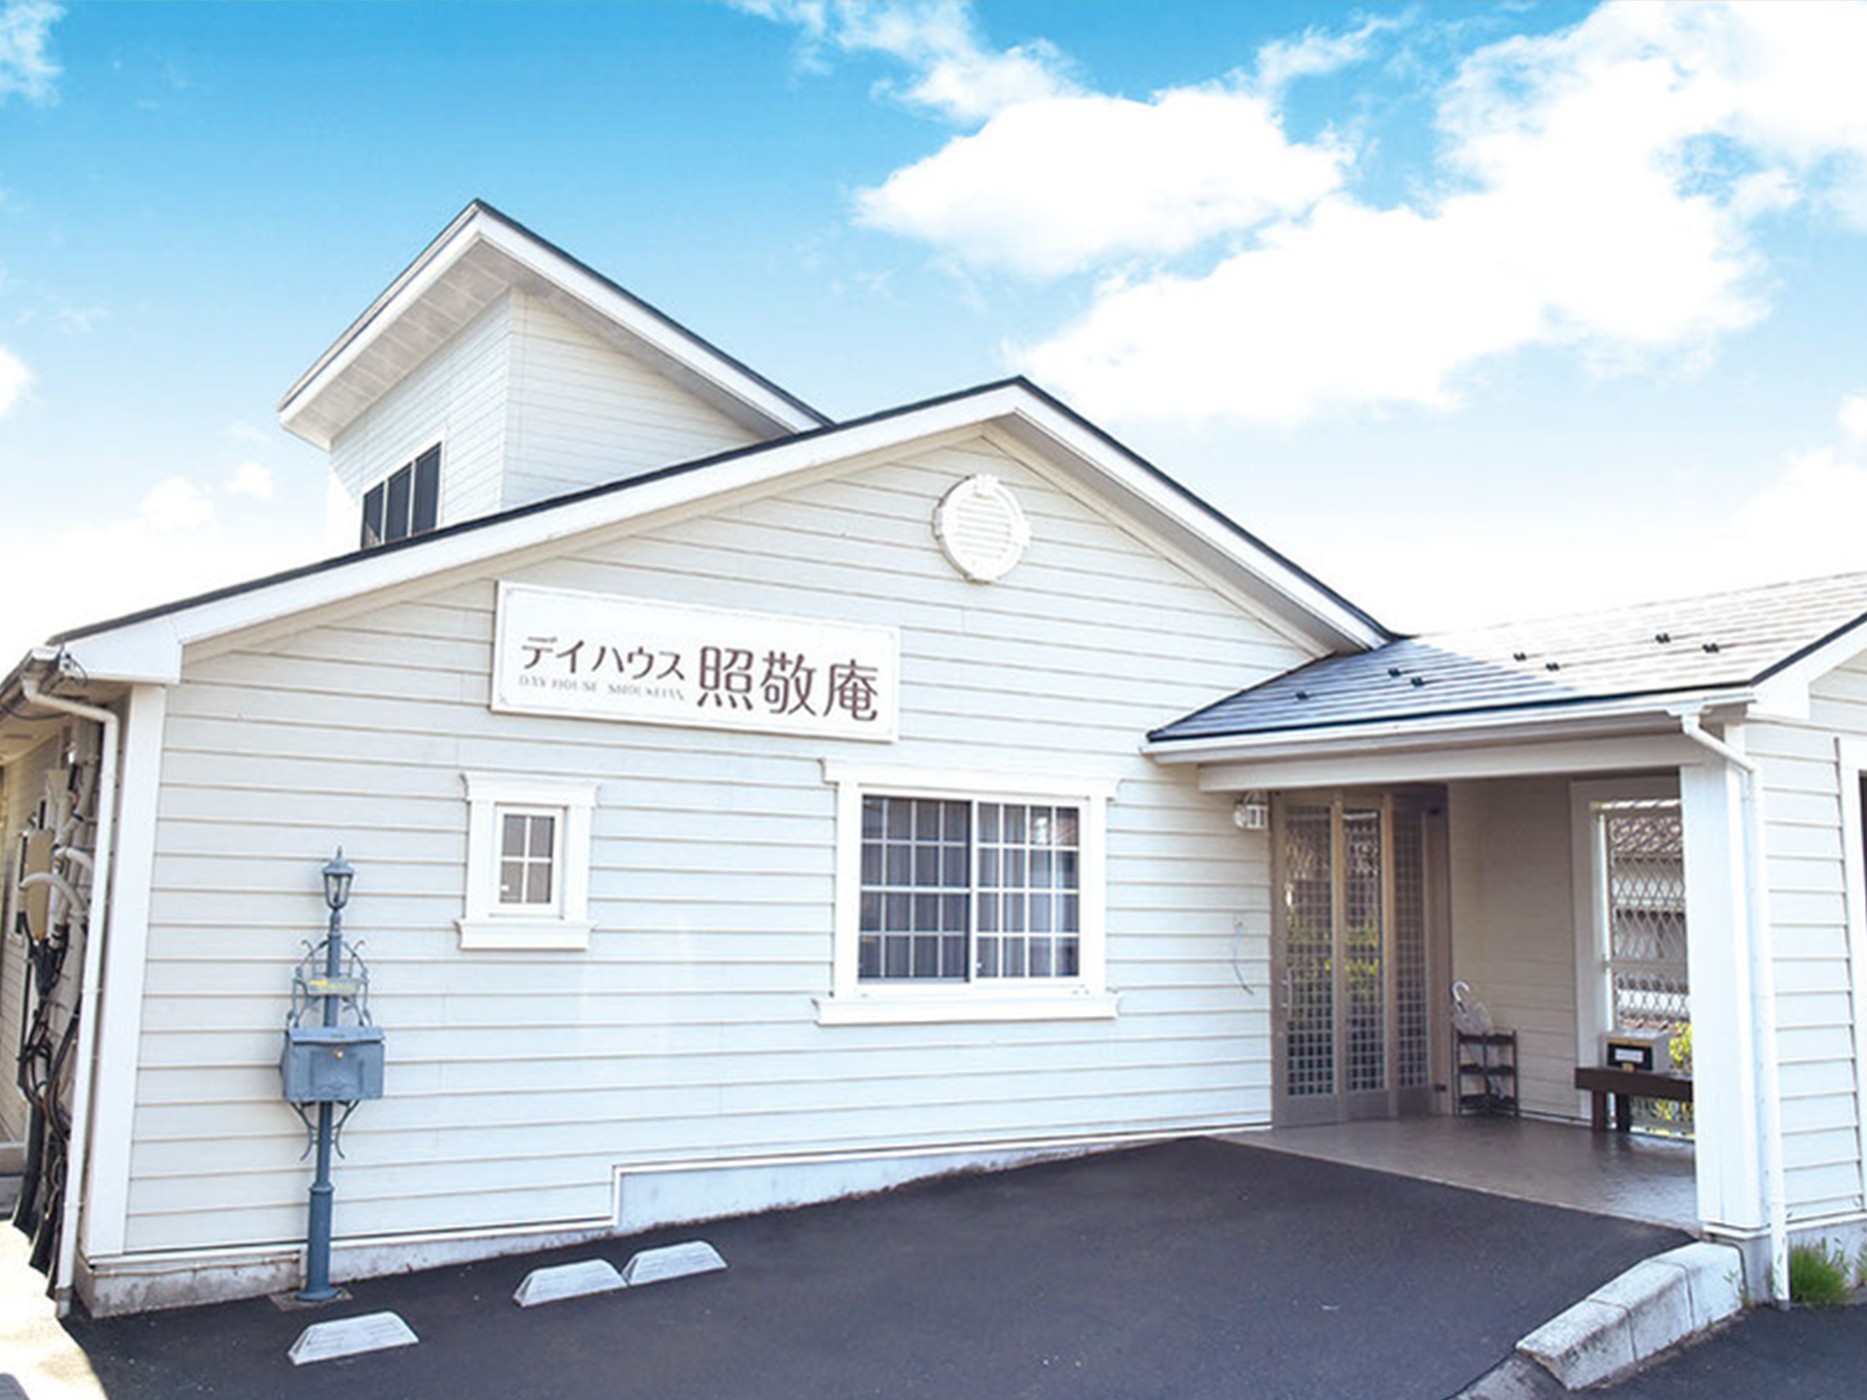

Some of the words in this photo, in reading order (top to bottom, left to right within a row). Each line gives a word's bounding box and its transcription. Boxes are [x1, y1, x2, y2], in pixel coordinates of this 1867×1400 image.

[518, 675, 547, 688] DAY
[551, 677, 597, 693] HOUSE
[521, 636, 686, 681] デイハウス
[697, 645, 879, 722] 照敬庵
